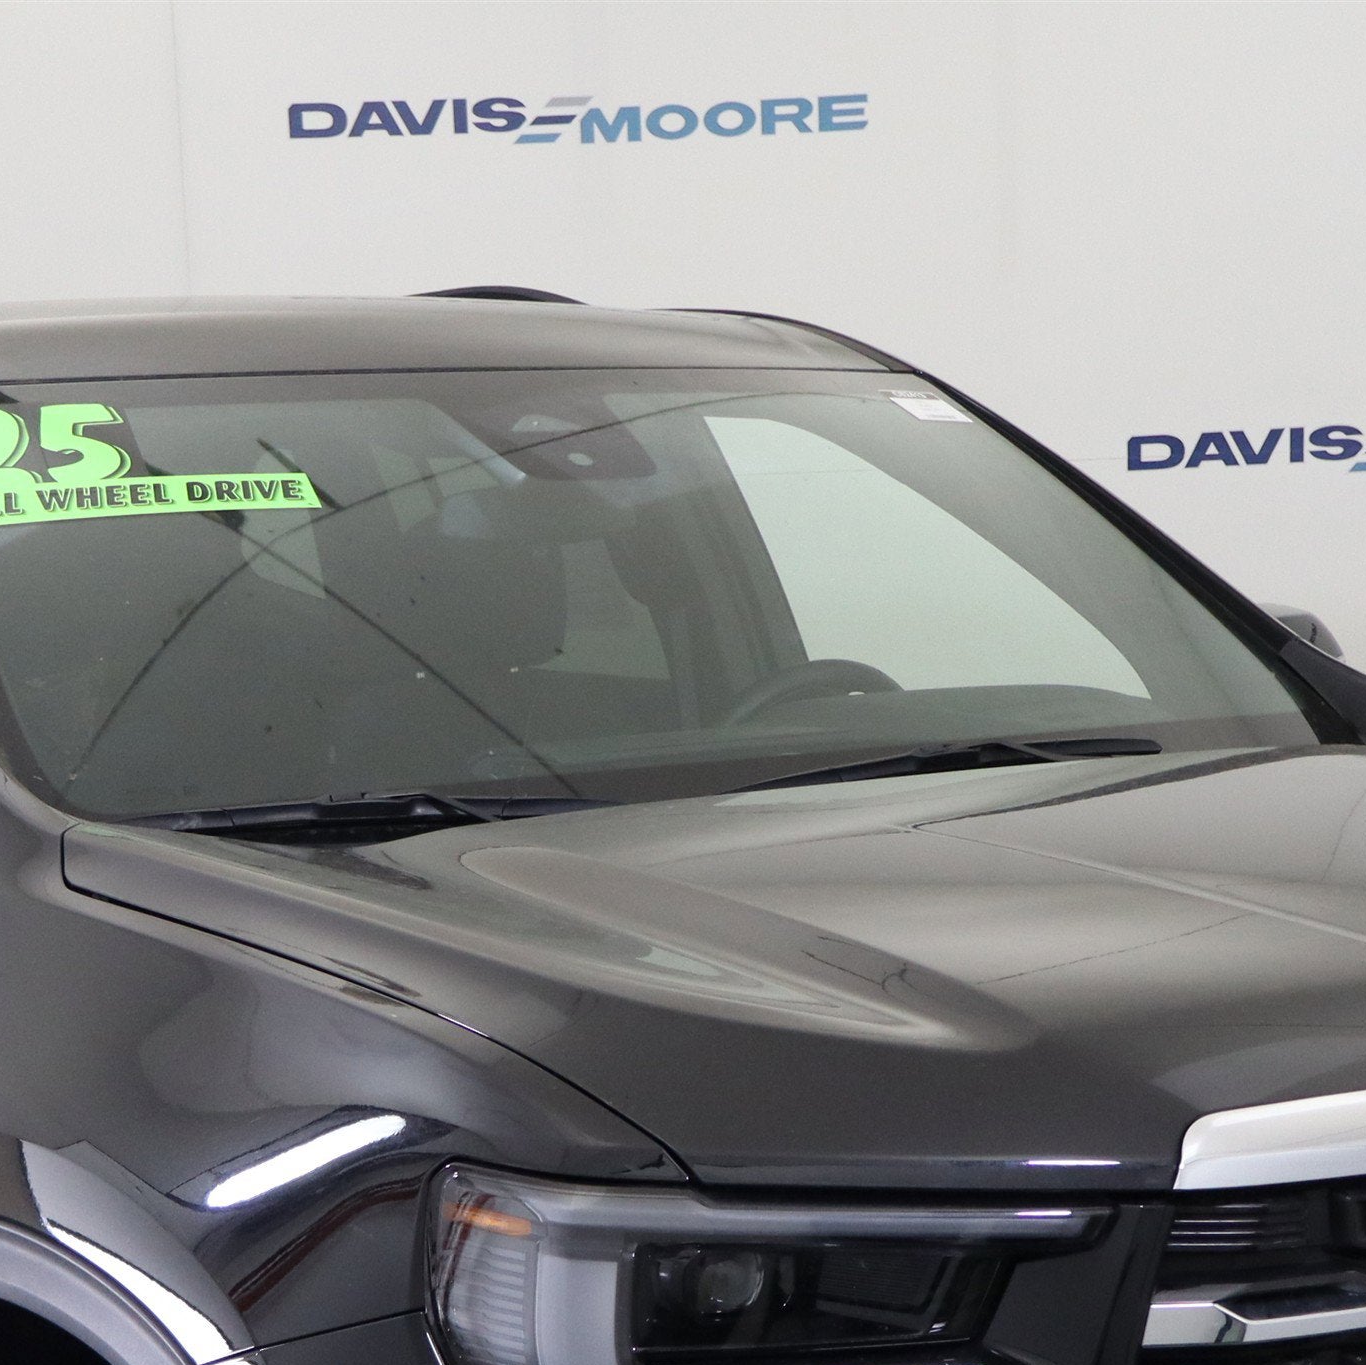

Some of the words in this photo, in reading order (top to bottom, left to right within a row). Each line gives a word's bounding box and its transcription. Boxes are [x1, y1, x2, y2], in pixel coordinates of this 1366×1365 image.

[287, 97, 527, 138] DAVIS
[579, 94, 869, 144] MOORE
[1127, 424, 1364, 471] DAVIS
[36, 482, 174, 512] WHEEL
[186, 478, 305, 504] DRIVE
